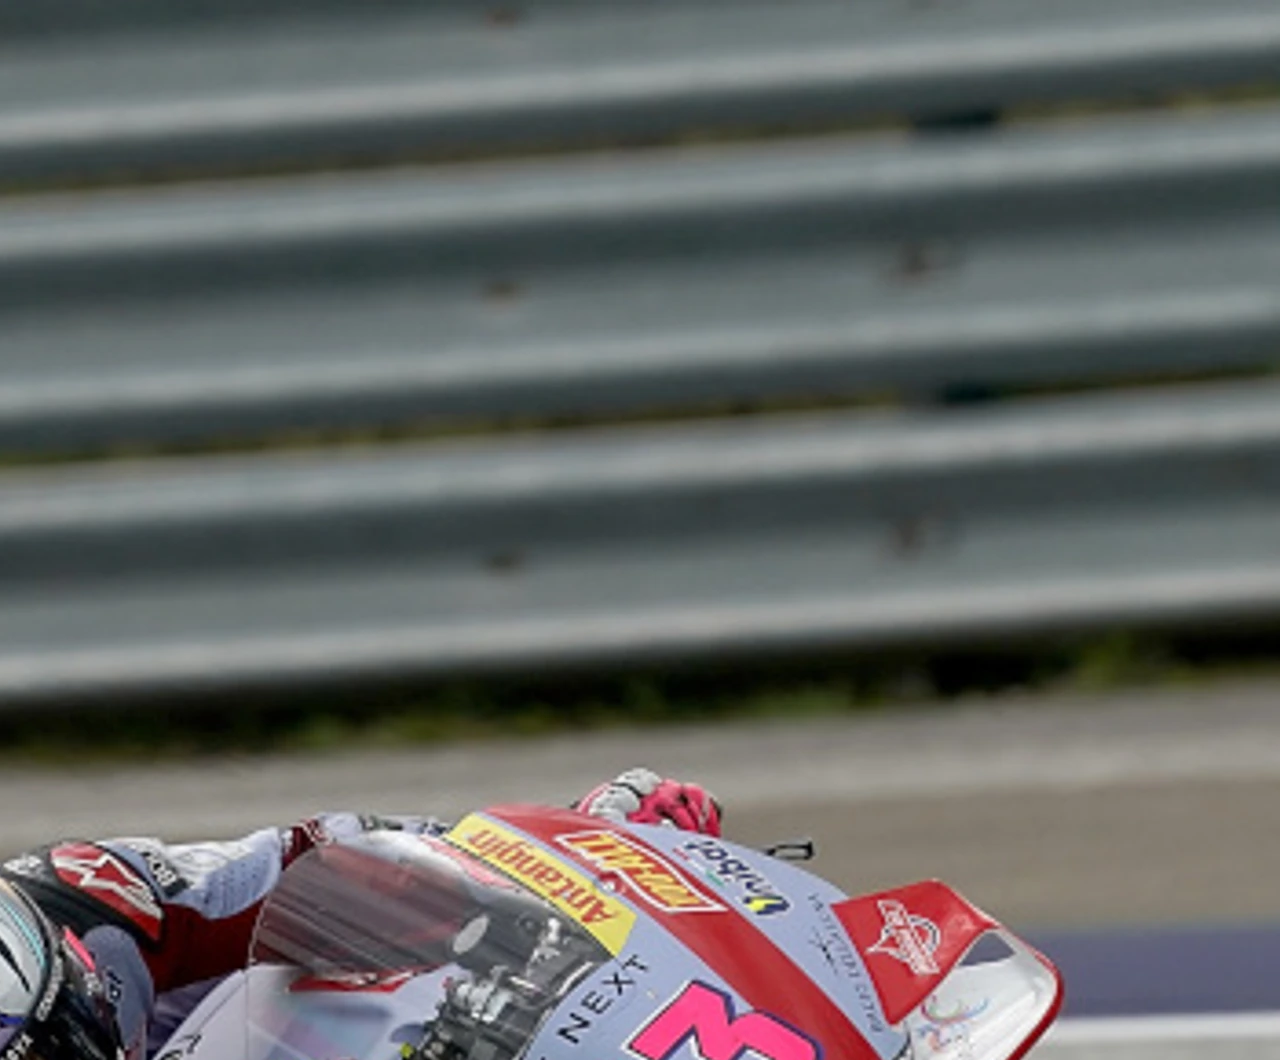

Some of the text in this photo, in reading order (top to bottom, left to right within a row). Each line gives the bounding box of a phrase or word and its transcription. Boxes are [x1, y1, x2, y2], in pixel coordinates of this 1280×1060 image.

[469, 829, 616, 923] Antangin
[686, 839, 790, 915] Unibat
[556, 953, 649, 1044] NEXT
